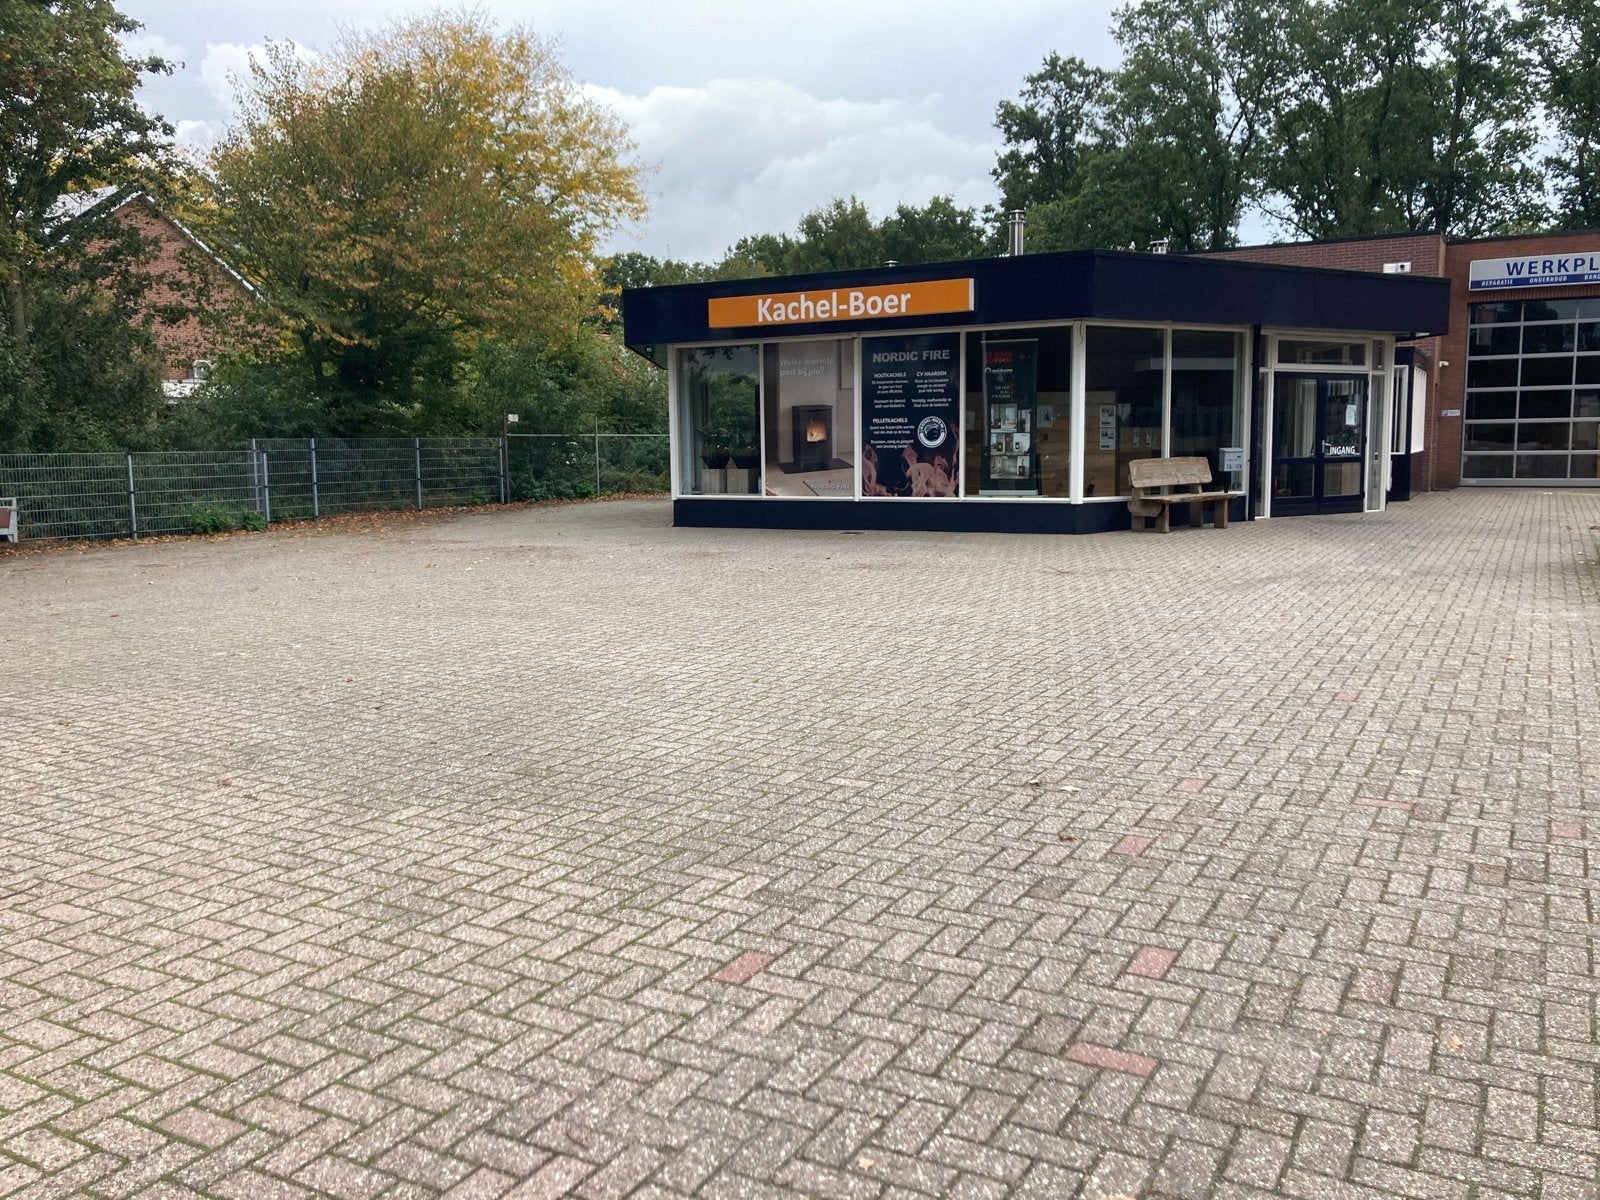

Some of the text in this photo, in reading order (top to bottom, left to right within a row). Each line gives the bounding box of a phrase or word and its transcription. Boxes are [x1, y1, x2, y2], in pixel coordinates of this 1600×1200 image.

[1529, 275, 1568, 284] ONDERHOUD
[757, 290, 912, 323] Kachel-Boer
[872, 349, 950, 362] NORDIC FIRE
[780, 358, 802, 366] Welke
[1329, 446, 1355, 455] INGANG
